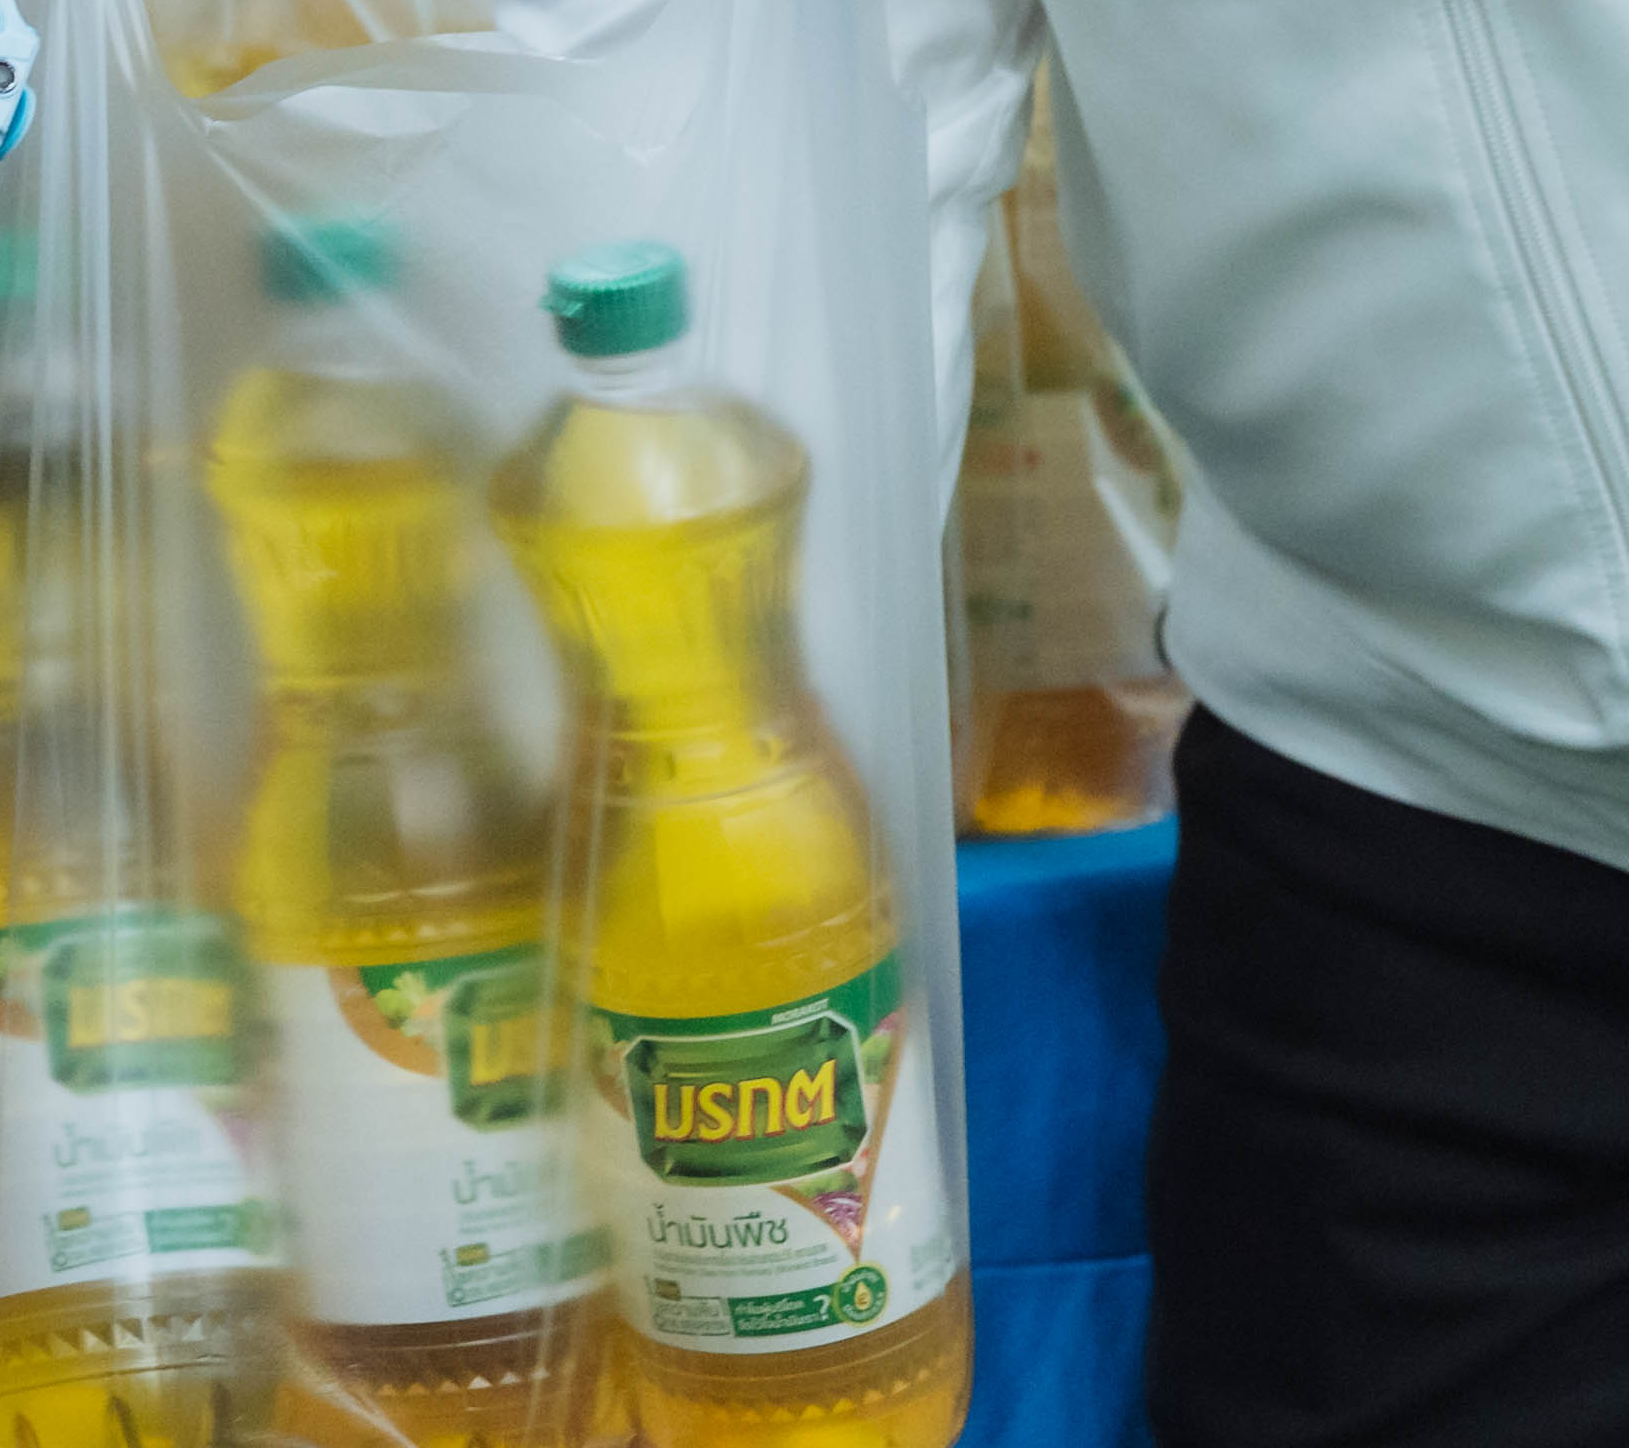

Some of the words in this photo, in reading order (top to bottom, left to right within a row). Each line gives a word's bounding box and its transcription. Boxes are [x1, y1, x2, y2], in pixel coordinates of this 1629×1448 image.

[652, 1057, 839, 1143] มรกต
[647, 1203, 789, 1249] น้ำมันพืช
